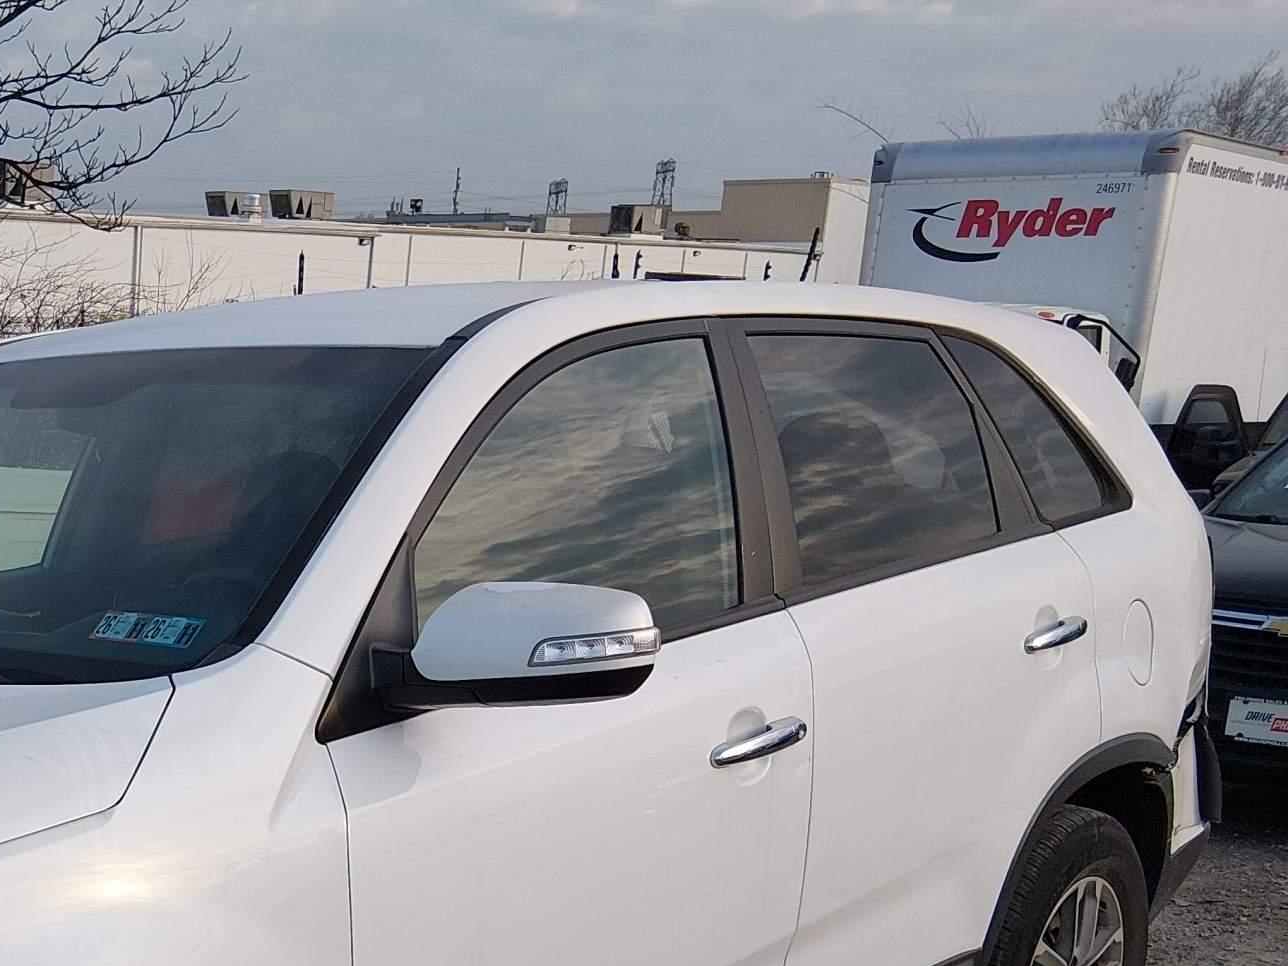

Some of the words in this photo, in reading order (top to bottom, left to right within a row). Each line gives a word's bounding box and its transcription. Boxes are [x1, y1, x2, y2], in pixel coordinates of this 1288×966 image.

[1186, 157, 1211, 176] Rental
[1210, 161, 1255, 184] Reservations:
[1096, 183, 1132, 194] 246971
[955, 196, 1116, 248] Ryder
[95, 615, 118, 634] 26
[144, 619, 167, 639] 26
[1245, 711, 1275, 722] DRIVE
